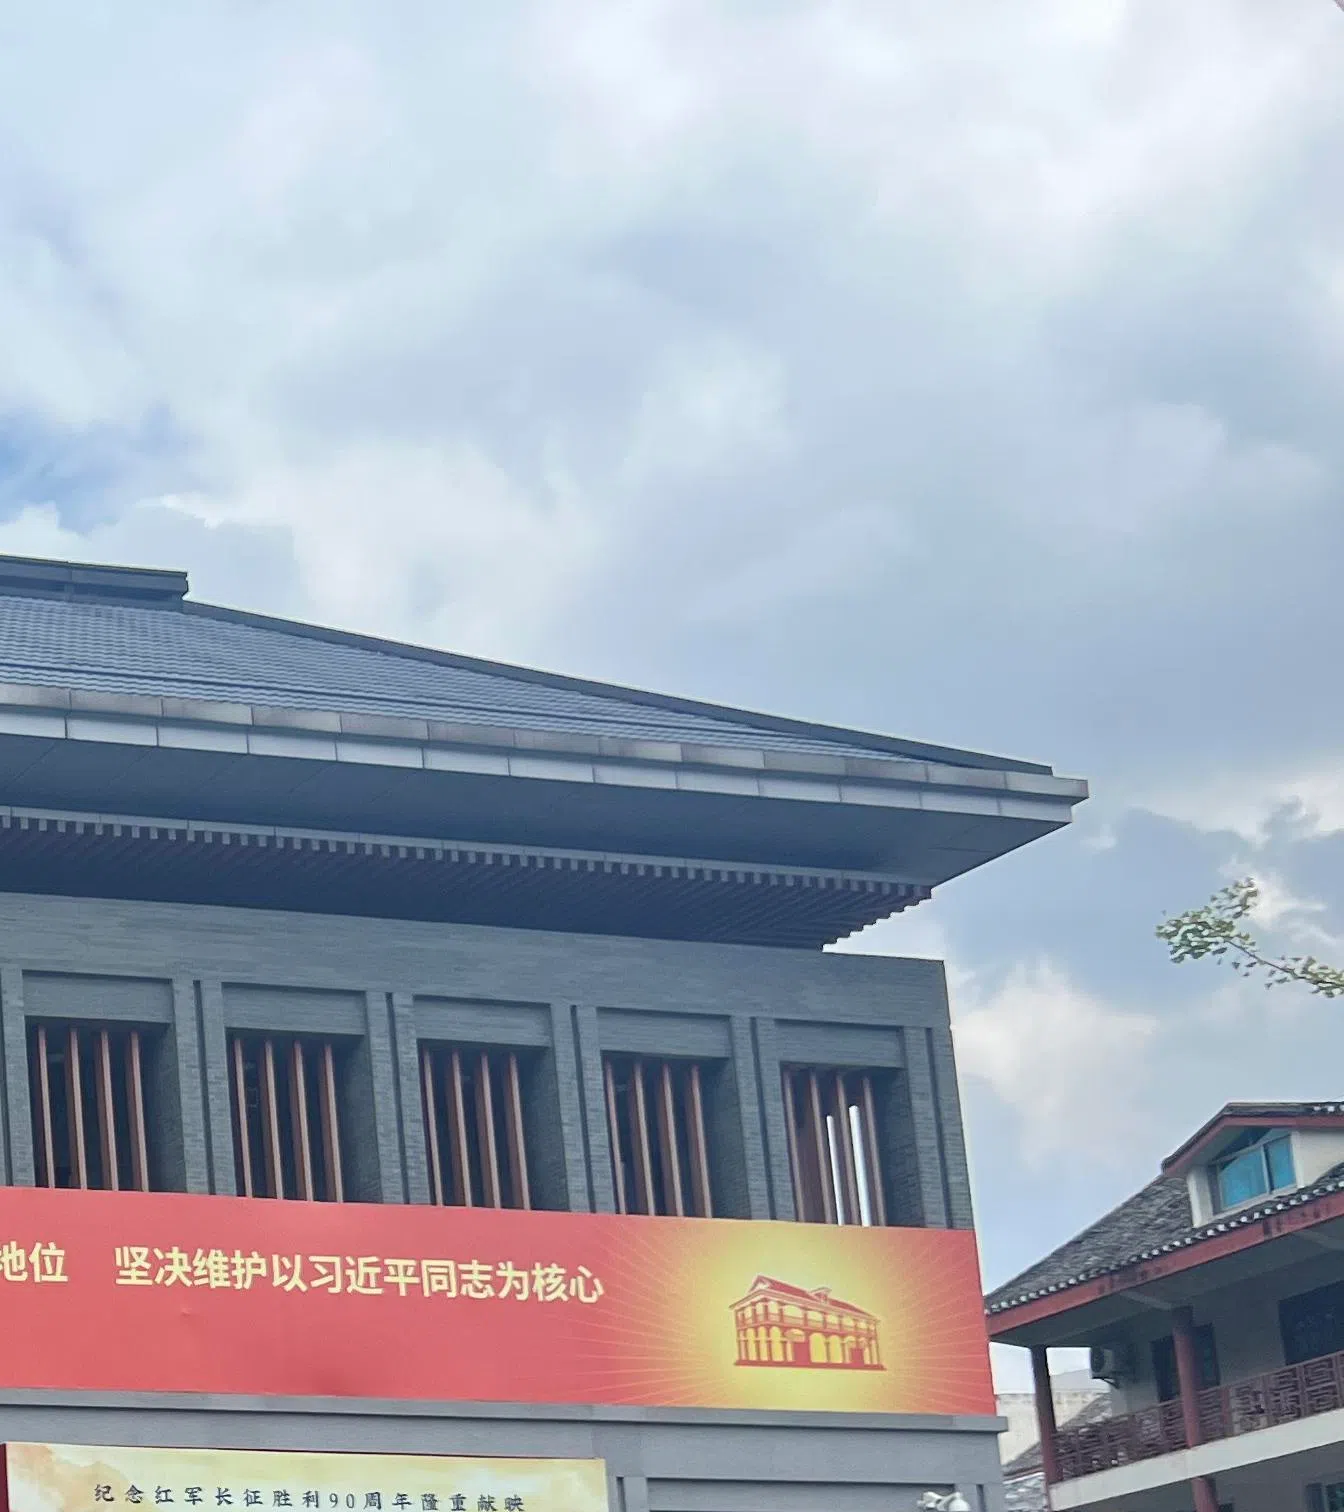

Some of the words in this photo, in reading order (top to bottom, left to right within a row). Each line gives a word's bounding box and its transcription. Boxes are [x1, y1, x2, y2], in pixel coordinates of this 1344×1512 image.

[115, 1244, 603, 1304] 坚决维护以习近平同志为核心
[94, 1484, 525, 1512] 纪念红军长征胜利90周年隆重献映
